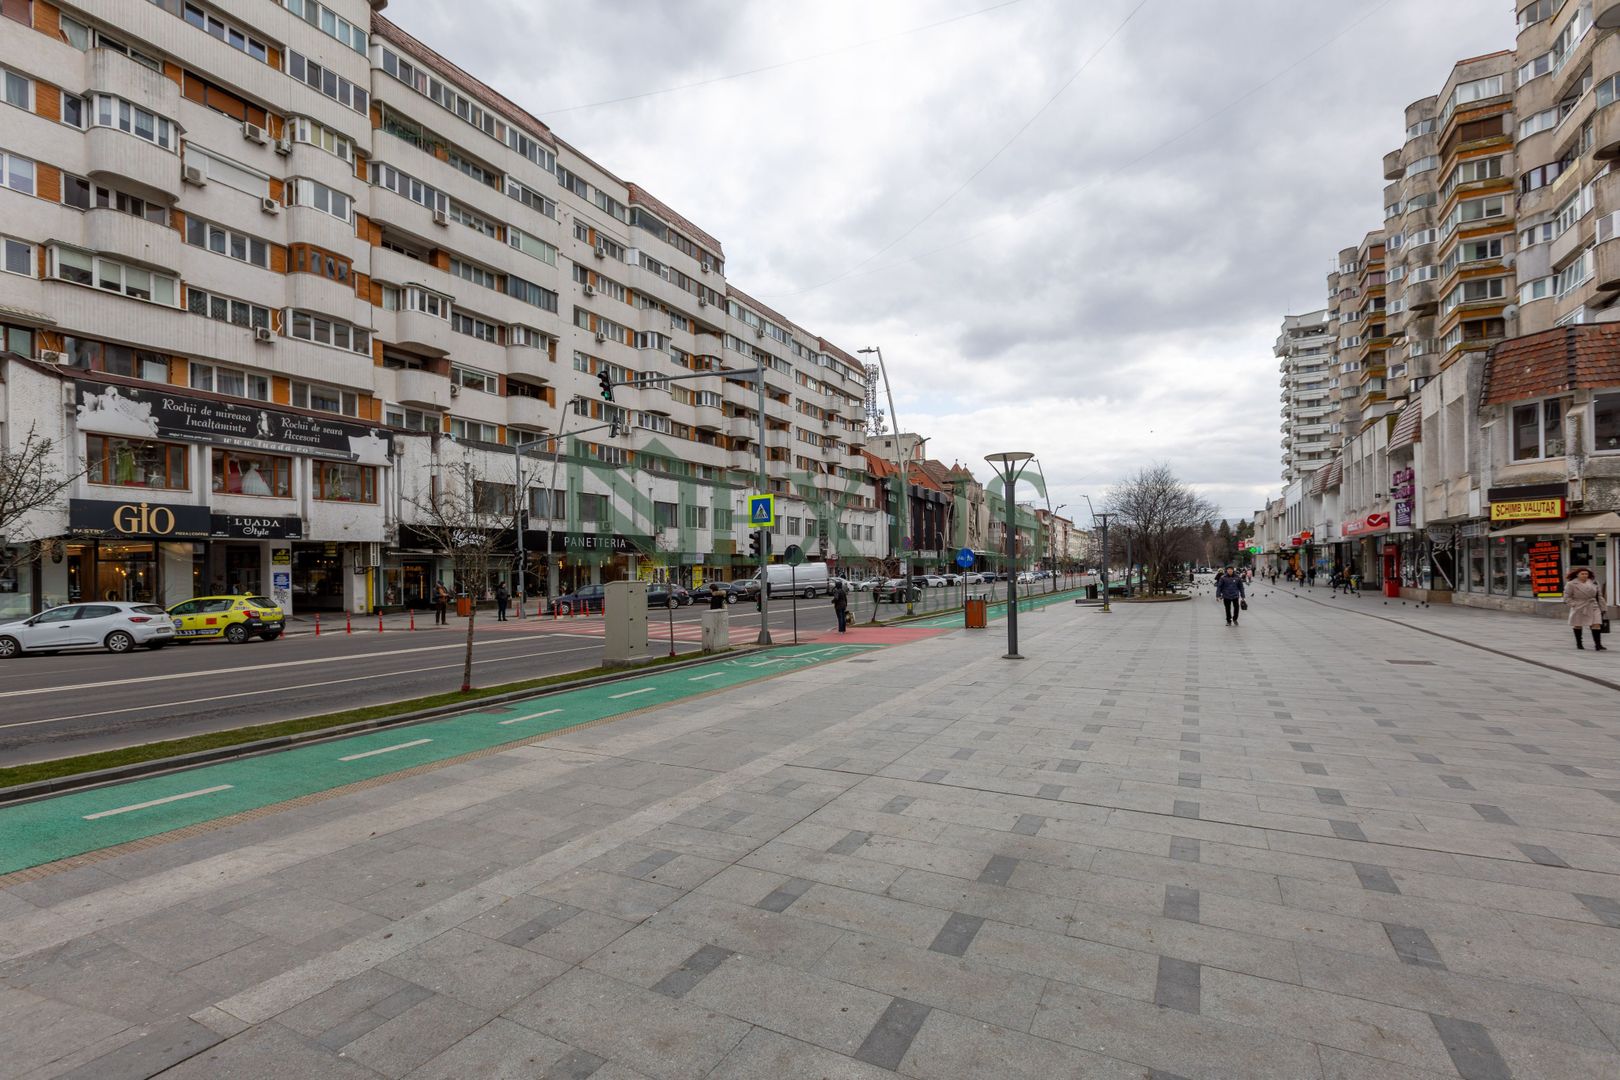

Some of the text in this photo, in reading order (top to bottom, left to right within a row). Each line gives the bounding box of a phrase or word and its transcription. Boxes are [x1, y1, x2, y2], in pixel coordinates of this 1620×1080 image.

[162, 398, 197, 413] Rochii
[201, 405, 213, 416] de
[281, 417, 309, 430] Rochii
[311, 423, 321, 432] de
[283, 429, 320, 443] Accesorii
[1496, 501, 1555, 517] SCHIMB VALUTAR
[234, 518, 280, 527] LUADA
[242, 523, 270, 537] Style
[563, 536, 627, 549] PANETTERIA
